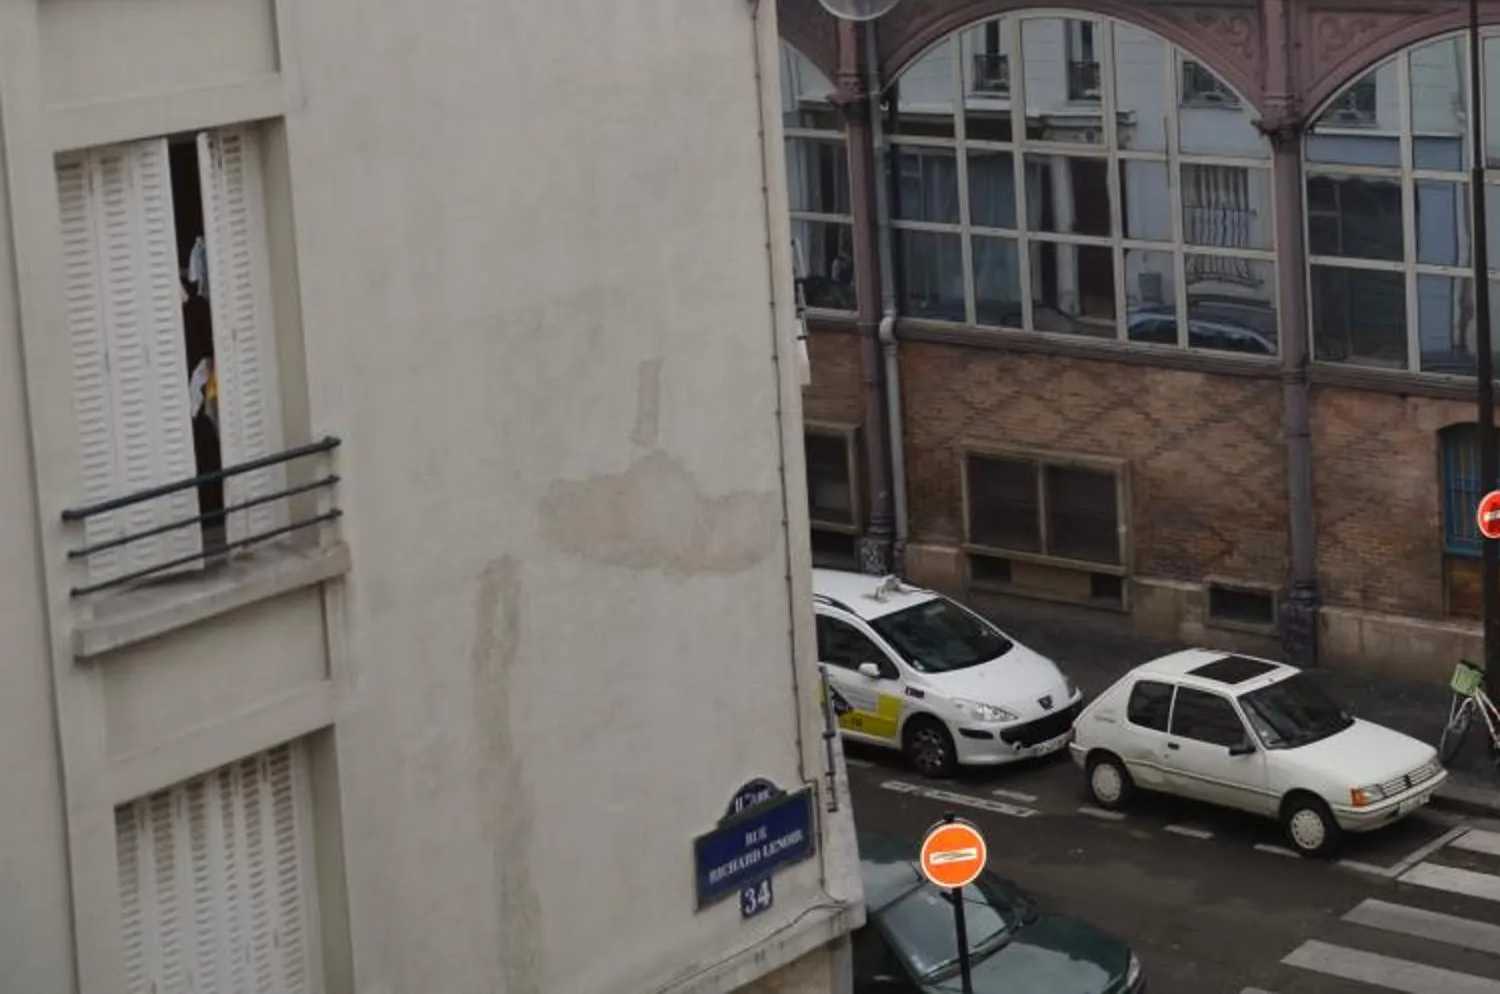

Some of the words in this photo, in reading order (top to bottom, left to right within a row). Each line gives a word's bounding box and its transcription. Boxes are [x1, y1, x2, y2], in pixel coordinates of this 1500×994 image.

[745, 825, 768, 846] RUE
[709, 848, 761, 885] RICHARD
[762, 828, 804, 858] LENOIR
[744, 879, 772, 915] 34
